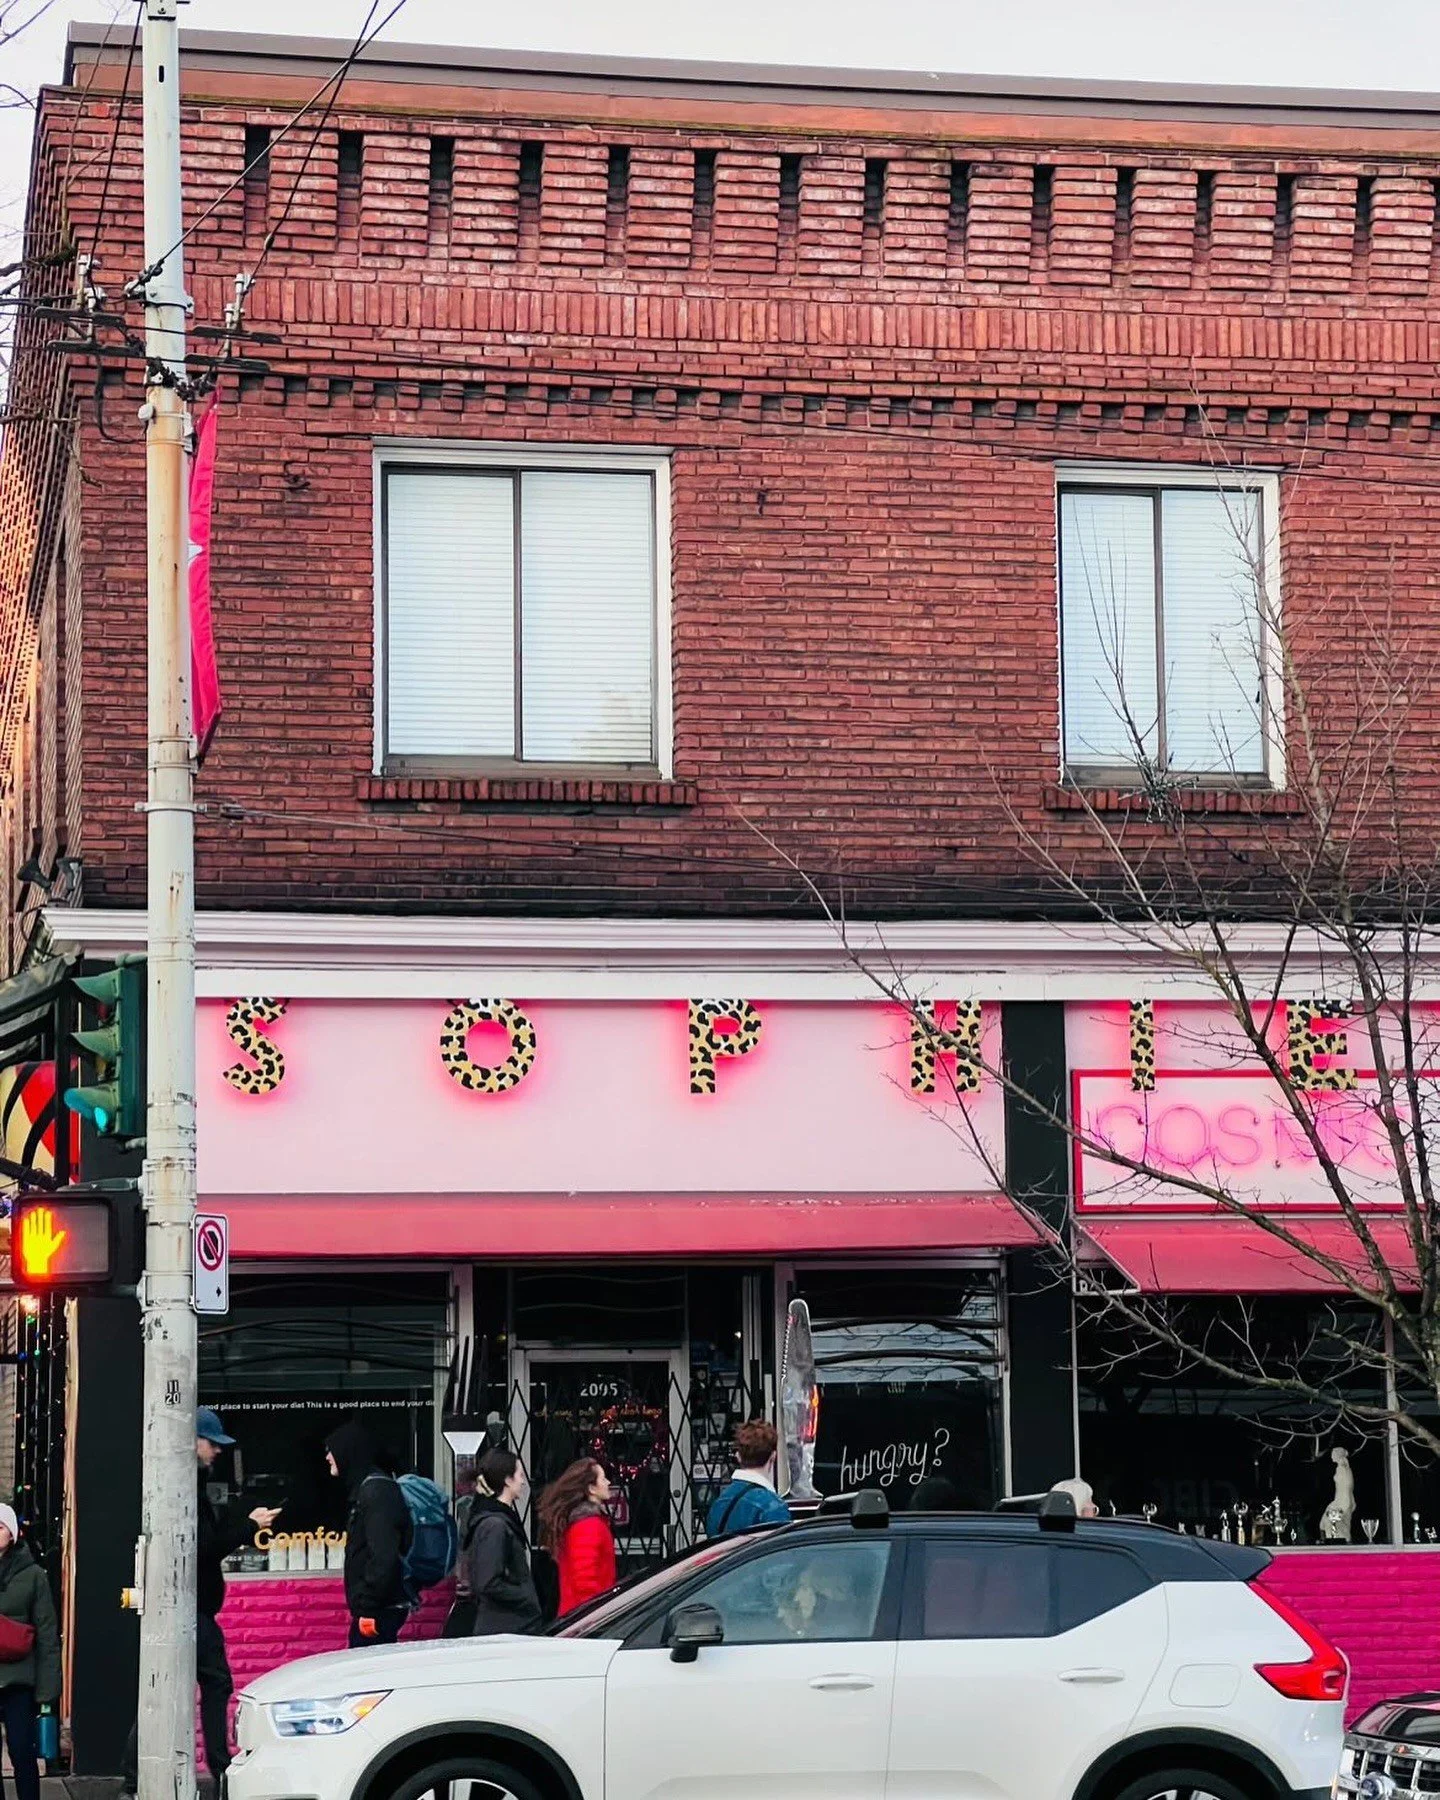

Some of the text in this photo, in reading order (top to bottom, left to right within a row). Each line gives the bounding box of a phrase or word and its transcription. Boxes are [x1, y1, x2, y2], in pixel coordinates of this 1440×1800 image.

[166, 1392, 180, 1404] 20
[220, 1403, 241, 1411] place
[252, 1402, 270, 1410] start
[271, 1402, 289, 1411] your
[307, 1400, 322, 1409] This
[339, 1401, 359, 1410] good
[360, 1401, 380, 1410] place
[381, 1400, 390, 1408] to
[391, 1400, 405, 1408] end
[407, 1401, 424, 1409] your
[840, 1427, 950, 1491] hungry?
